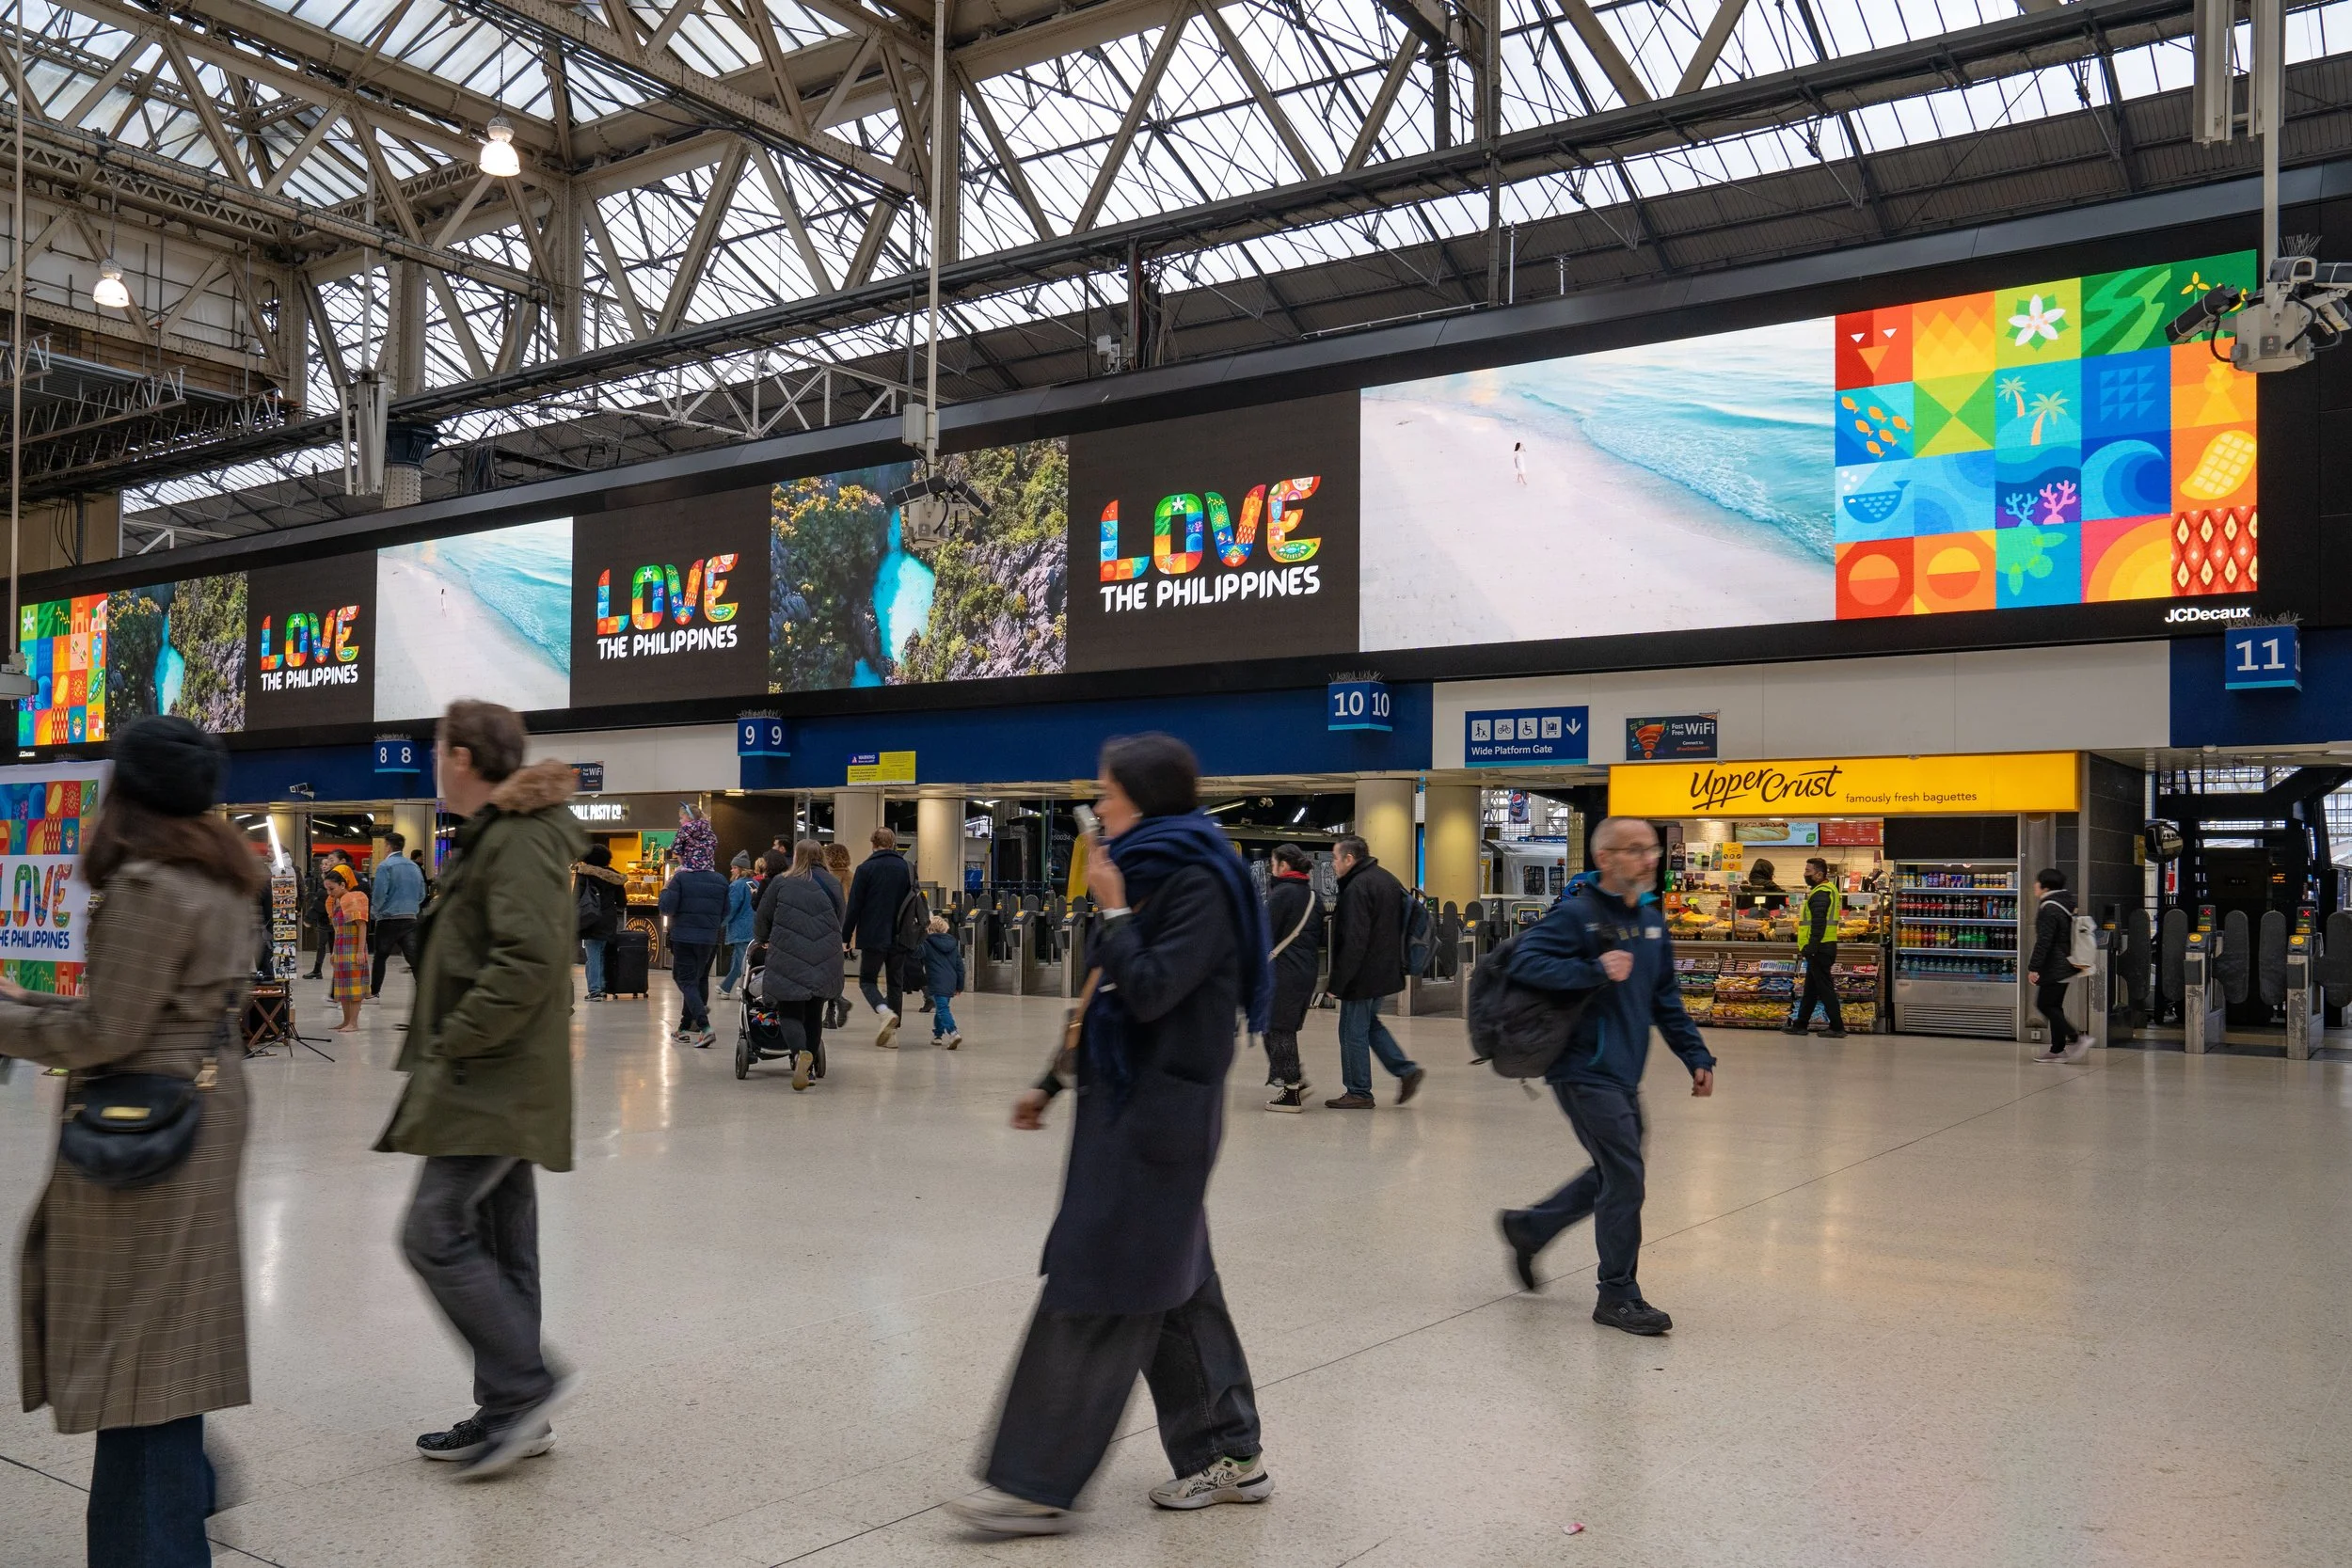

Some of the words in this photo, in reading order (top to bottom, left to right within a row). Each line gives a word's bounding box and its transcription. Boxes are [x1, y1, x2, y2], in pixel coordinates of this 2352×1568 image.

[1100, 476, 1321, 582] LOVE
[596, 553, 739, 635] LOVE
[1100, 581, 1149, 612] THE
[1156, 564, 1321, 608] PHILIPPINES
[2165, 607, 2251, 623] JCDecaux
[261, 605, 359, 671] LOVE
[596, 636, 628, 659] THE
[632, 625, 738, 657] PHILIPPINES
[2235, 638, 2286, 672] 11
[261, 672, 283, 691] THE
[285, 664, 358, 689] PHILIPPINES
[1334, 690, 1364, 717] 10
[1372, 691, 1390, 718] 10
[745, 725, 755, 745] 9
[771, 725, 782, 745] 9
[1685, 722, 1715, 735] WiFi
[380, 746, 387, 764] 8
[401, 746, 411, 764] 8
[1471, 746, 1493, 755] Wide
[1494, 745, 1531, 755] Platform
[1533, 744, 1553, 753] Gate
[589, 767, 602, 776] WiFi
[1690, 768, 1773, 811] Upper
[1761, 765, 1843, 802] Crust
[1846, 793, 1891, 804] famously
[1894, 792, 1919, 801] fresh
[1923, 791, 1978, 803] baguettes
[0, 929, 9, 947] HE
[11, 929, 70, 950] PHILIPPINES
